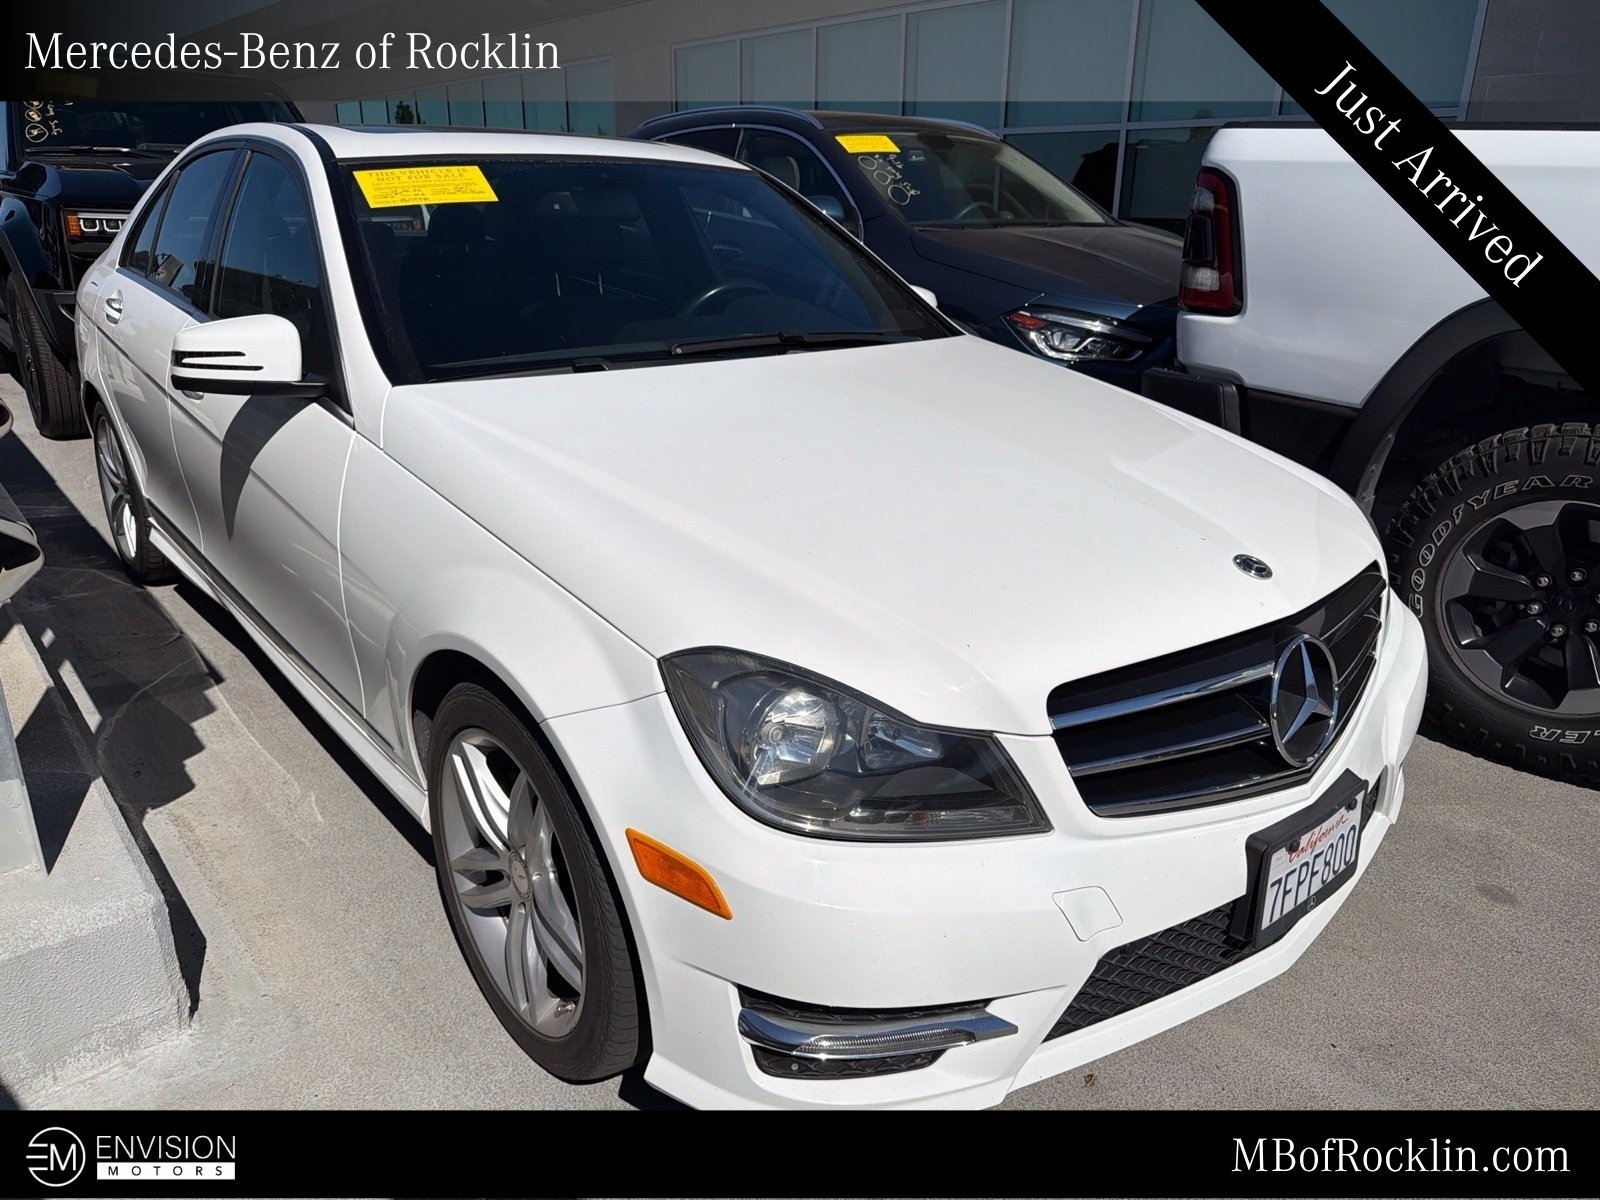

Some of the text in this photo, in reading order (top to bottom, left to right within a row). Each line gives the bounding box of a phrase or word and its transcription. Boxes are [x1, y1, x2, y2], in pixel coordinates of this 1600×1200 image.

[368, 170, 397, 178] THIS
[399, 167, 451, 176] VEHICLE
[375, 175, 401, 183] NOT
[406, 173, 431, 181] FOR
[1408, 474, 1593, 618] GOODYEAR
[1270, 824, 1357, 923] 7FPF800
